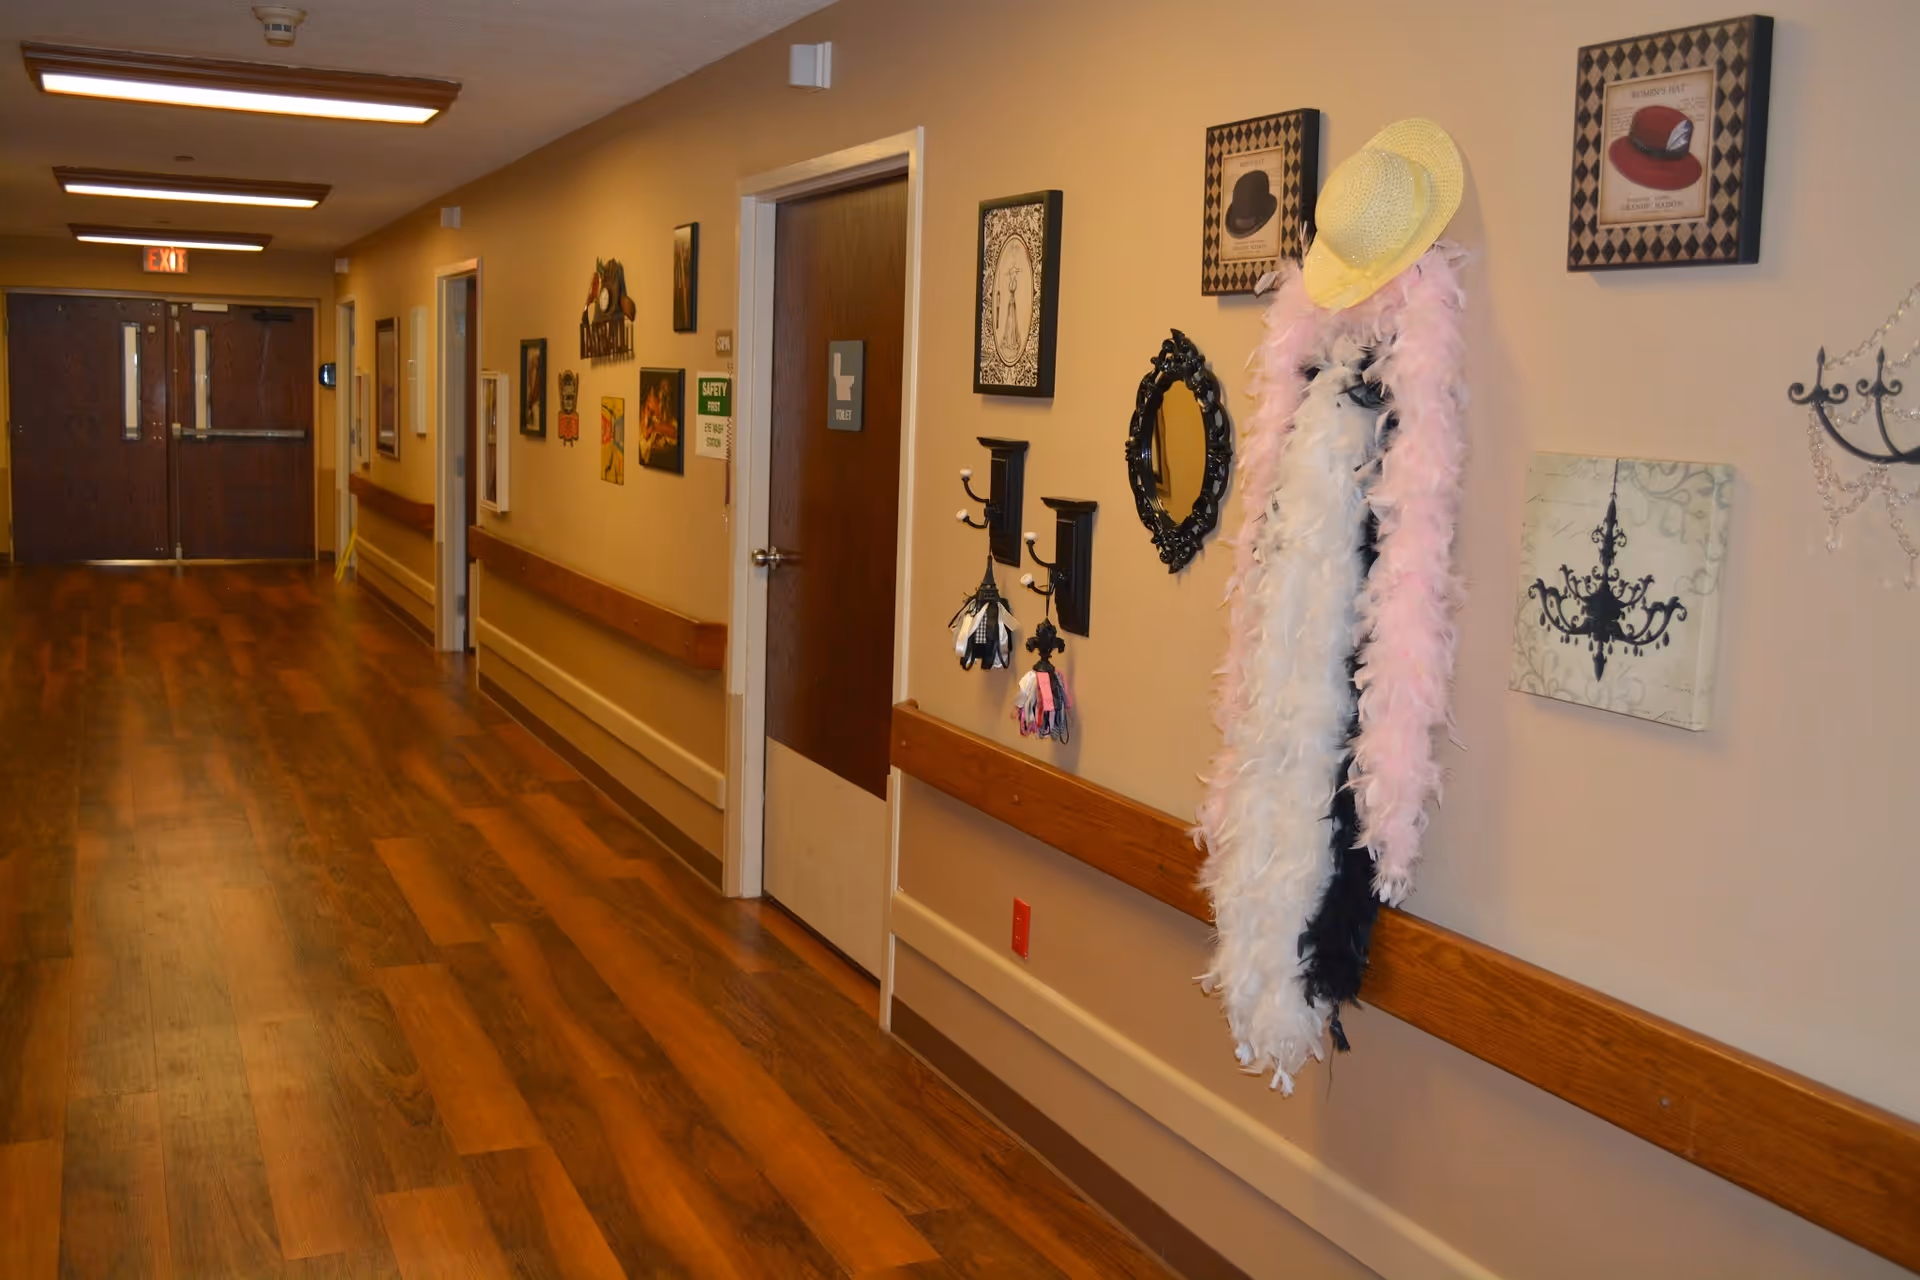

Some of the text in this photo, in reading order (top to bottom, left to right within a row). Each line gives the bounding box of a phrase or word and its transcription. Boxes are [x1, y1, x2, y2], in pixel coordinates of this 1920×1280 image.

[148, 248, 187, 273] EXIT
[702, 382, 728, 397] SAFETY
[707, 401, 721, 412] FIRST
[835, 409, 853, 421] TOILET
